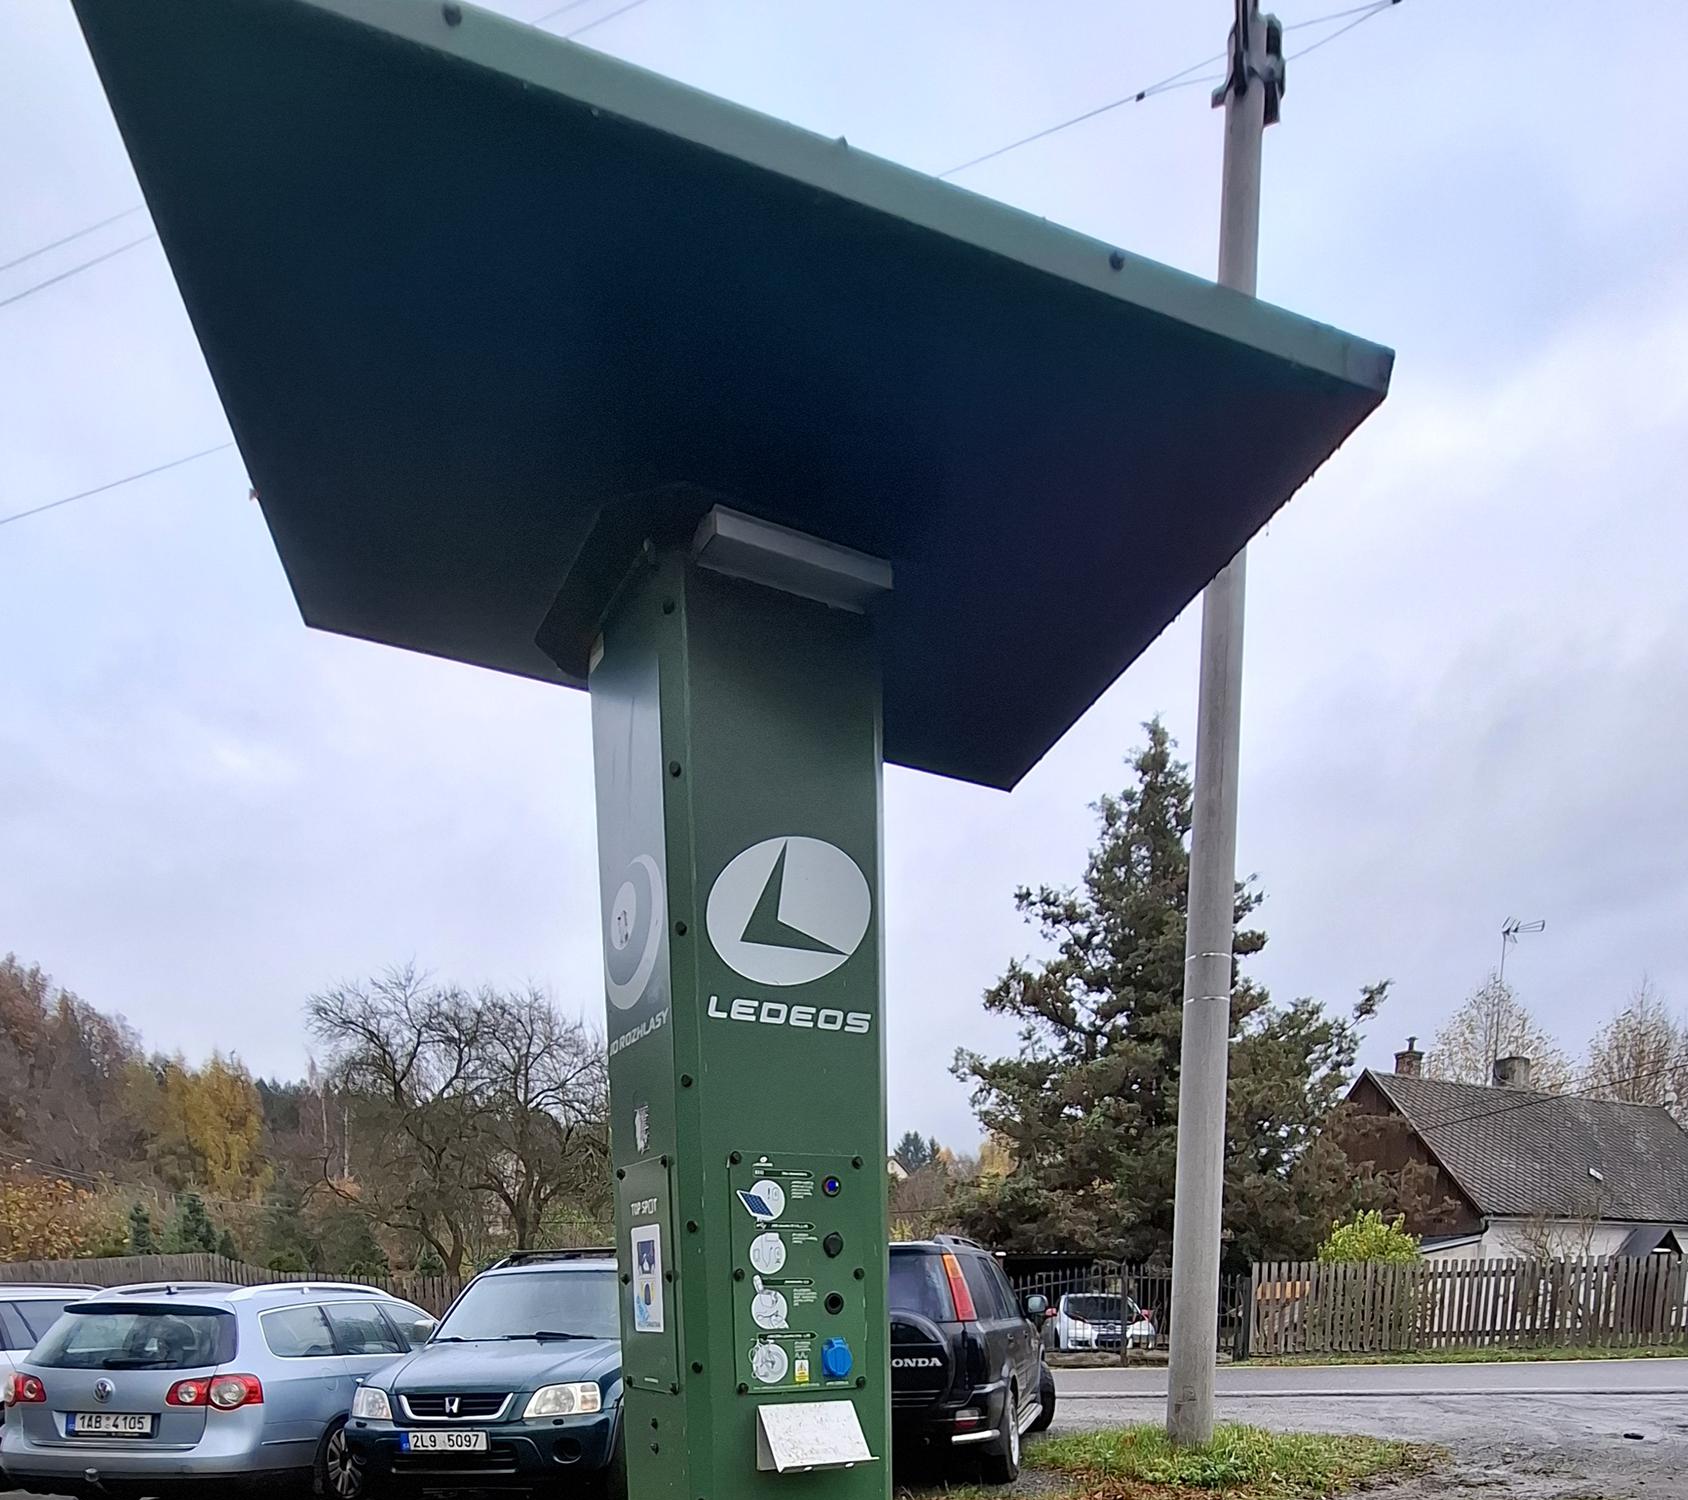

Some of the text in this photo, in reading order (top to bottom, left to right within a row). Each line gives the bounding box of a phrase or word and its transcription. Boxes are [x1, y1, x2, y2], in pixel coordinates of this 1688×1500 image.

[707, 995, 872, 1034] LEDEOS
[891, 1357, 943, 1367] ONDA
[79, 1414, 146, 1431] 1AB 4105
[412, 1433, 480, 1448] 2L9 5097
